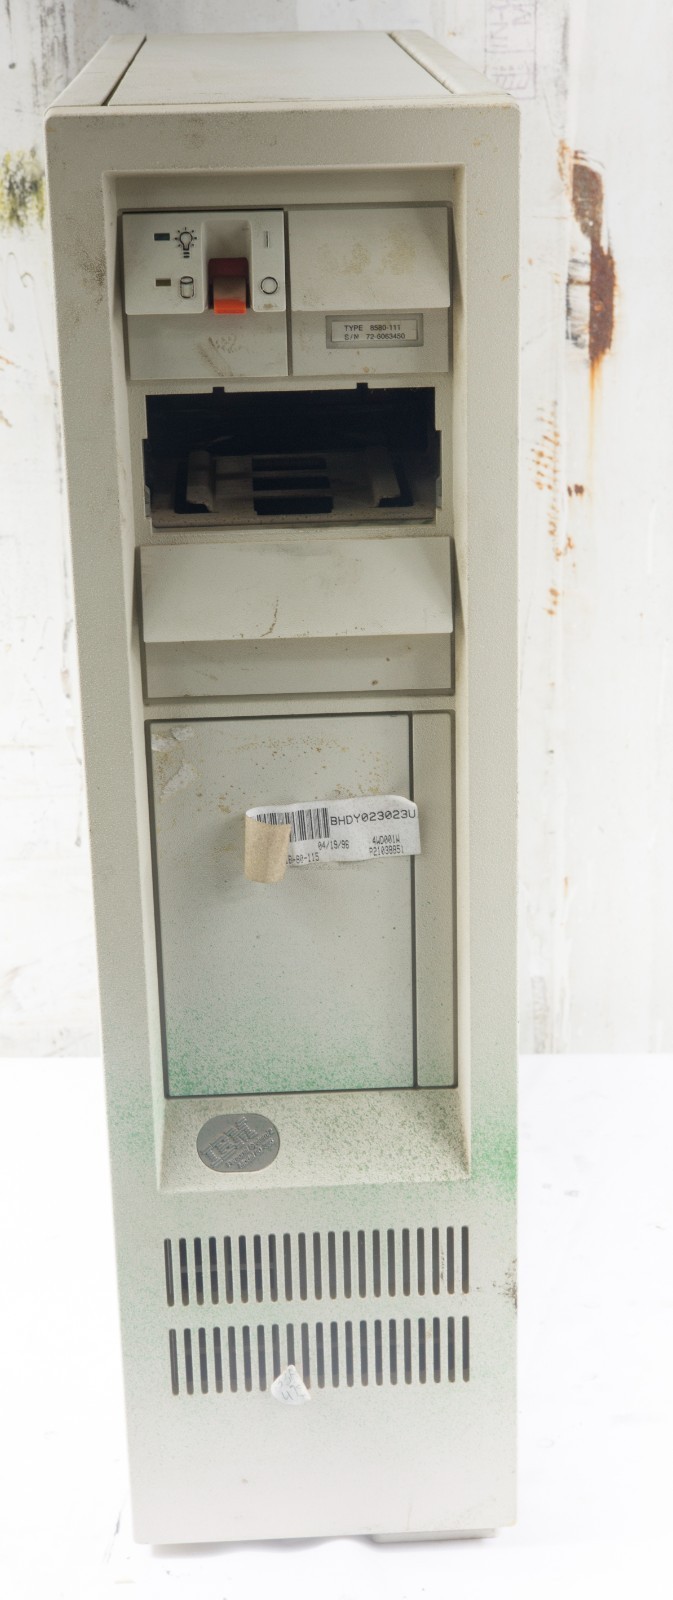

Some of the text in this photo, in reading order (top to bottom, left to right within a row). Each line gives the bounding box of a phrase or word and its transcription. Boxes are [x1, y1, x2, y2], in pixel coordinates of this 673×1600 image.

[344, 324, 401, 332] TYPE 8580-111
[344, 333, 360, 341] S/N
[330, 809, 416, 826] BHDY023023U
[317, 839, 350, 851] 04/19/96
[201, 1116, 258, 1168] IBM
